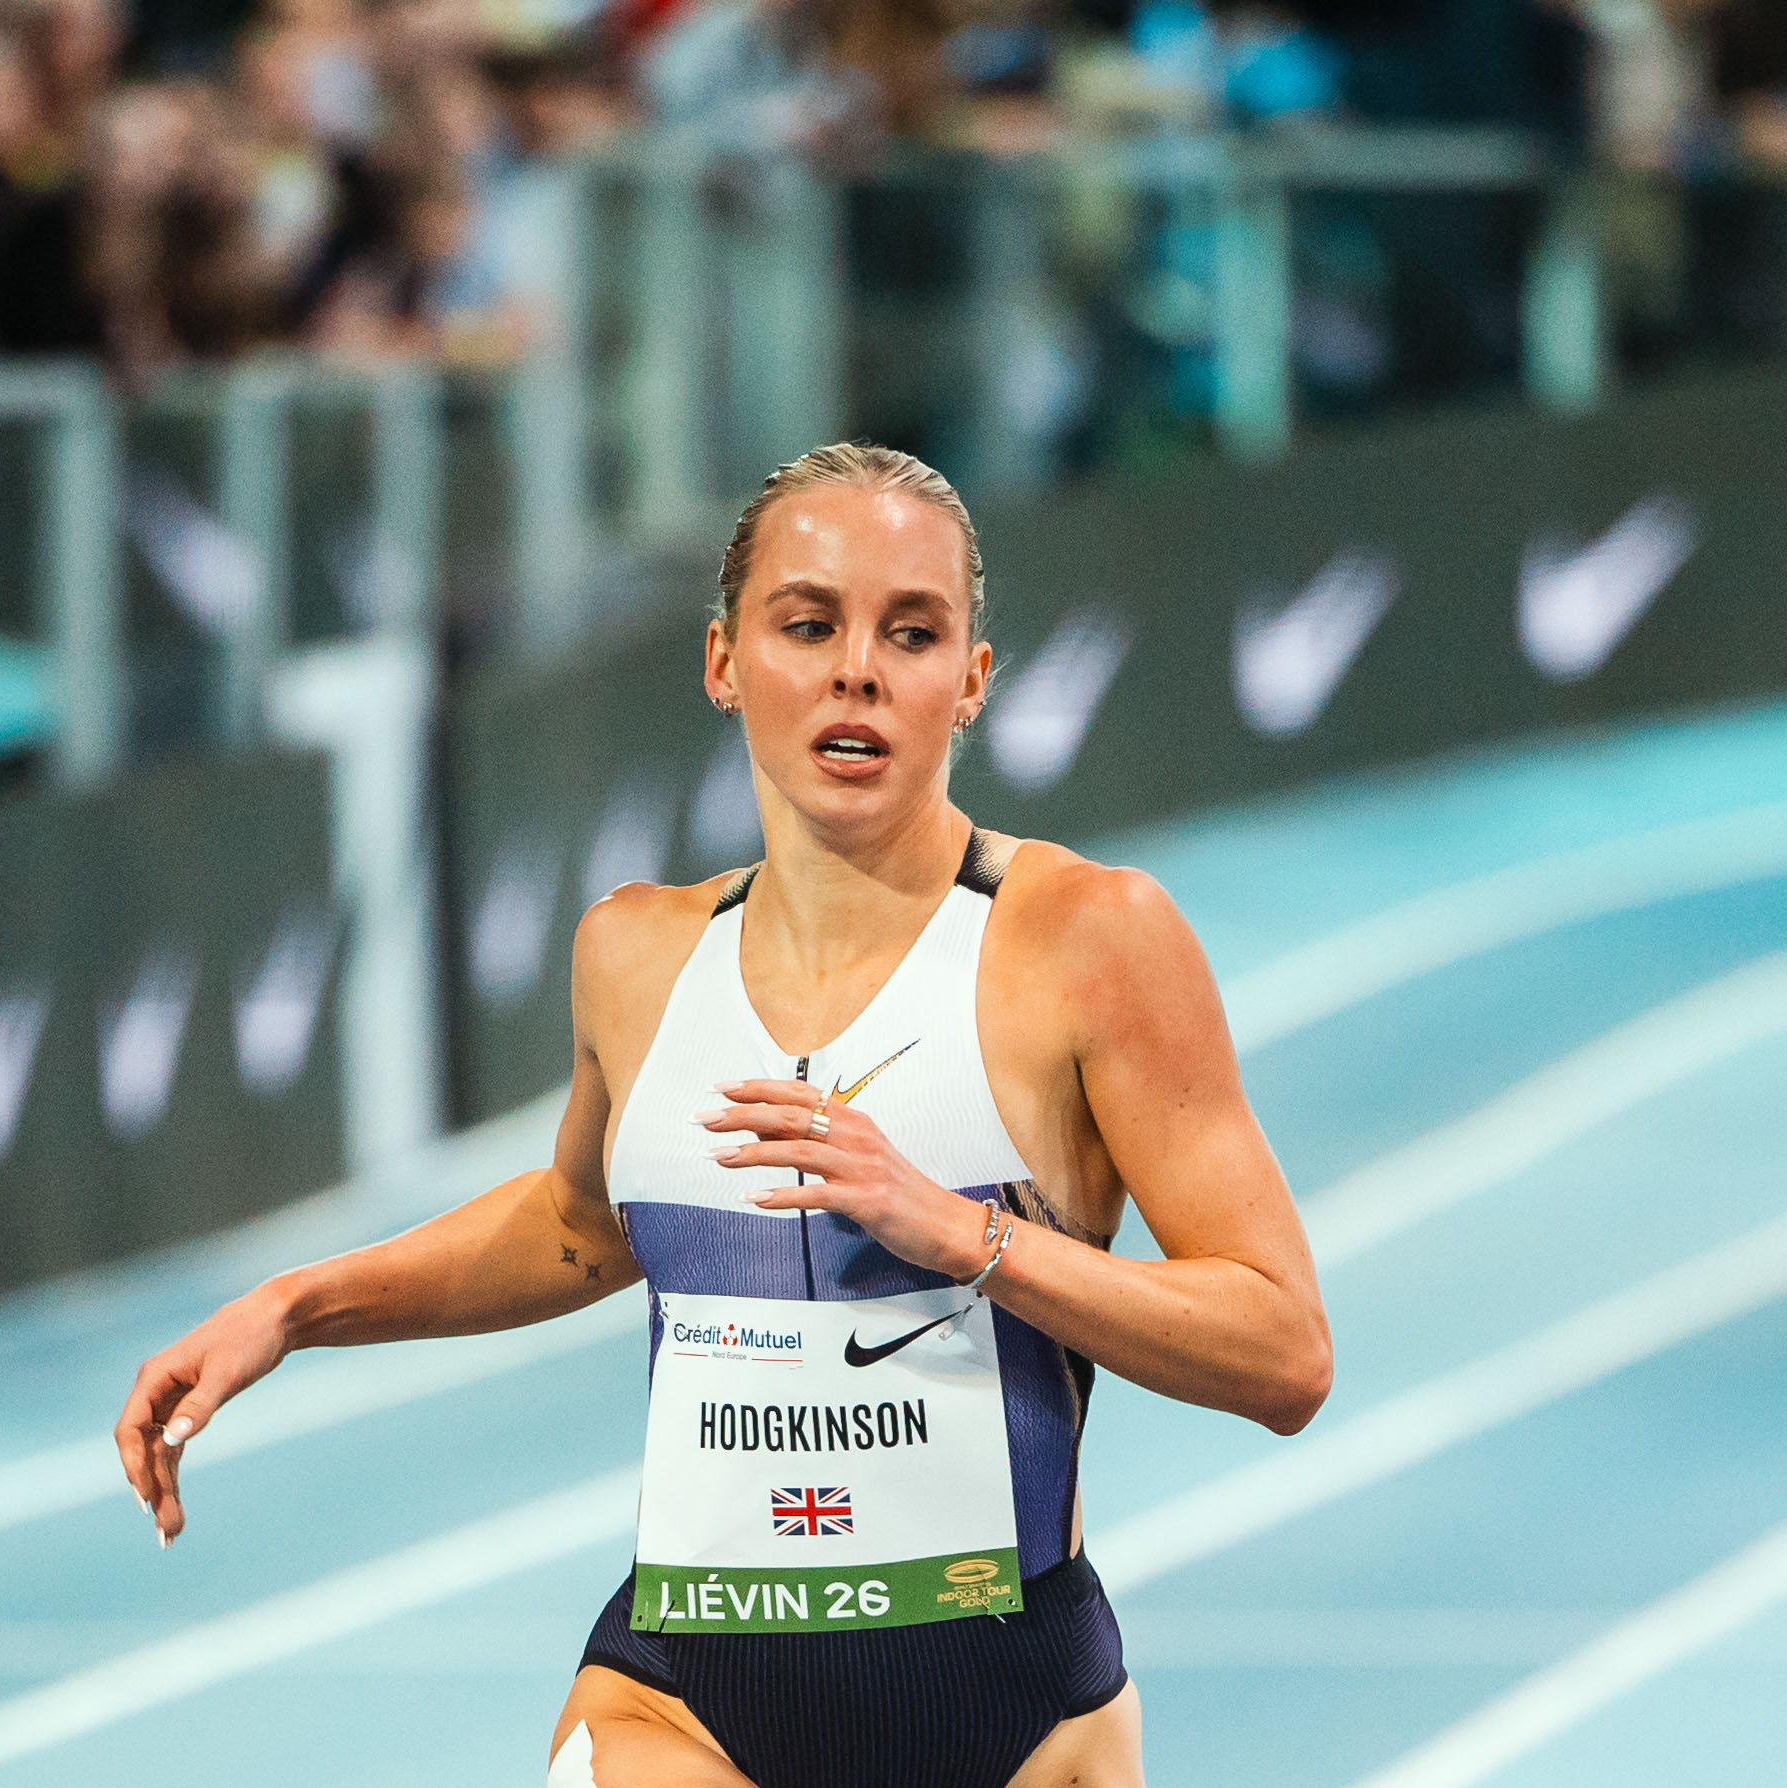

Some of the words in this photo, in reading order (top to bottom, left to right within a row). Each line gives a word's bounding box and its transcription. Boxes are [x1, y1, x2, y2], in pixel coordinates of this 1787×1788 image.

[673, 1323, 721, 1345] Crédit
[740, 1328, 802, 1349] Mutuel
[699, 1399, 929, 1452] HODGKINSON
[659, 1573, 810, 1621] LIÉVIN
[824, 1579, 891, 1619] 26
[937, 1588, 979, 1603] INDOOR
[981, 1585, 1011, 1596] TOUR
[959, 1596, 990, 1608] GOLD
